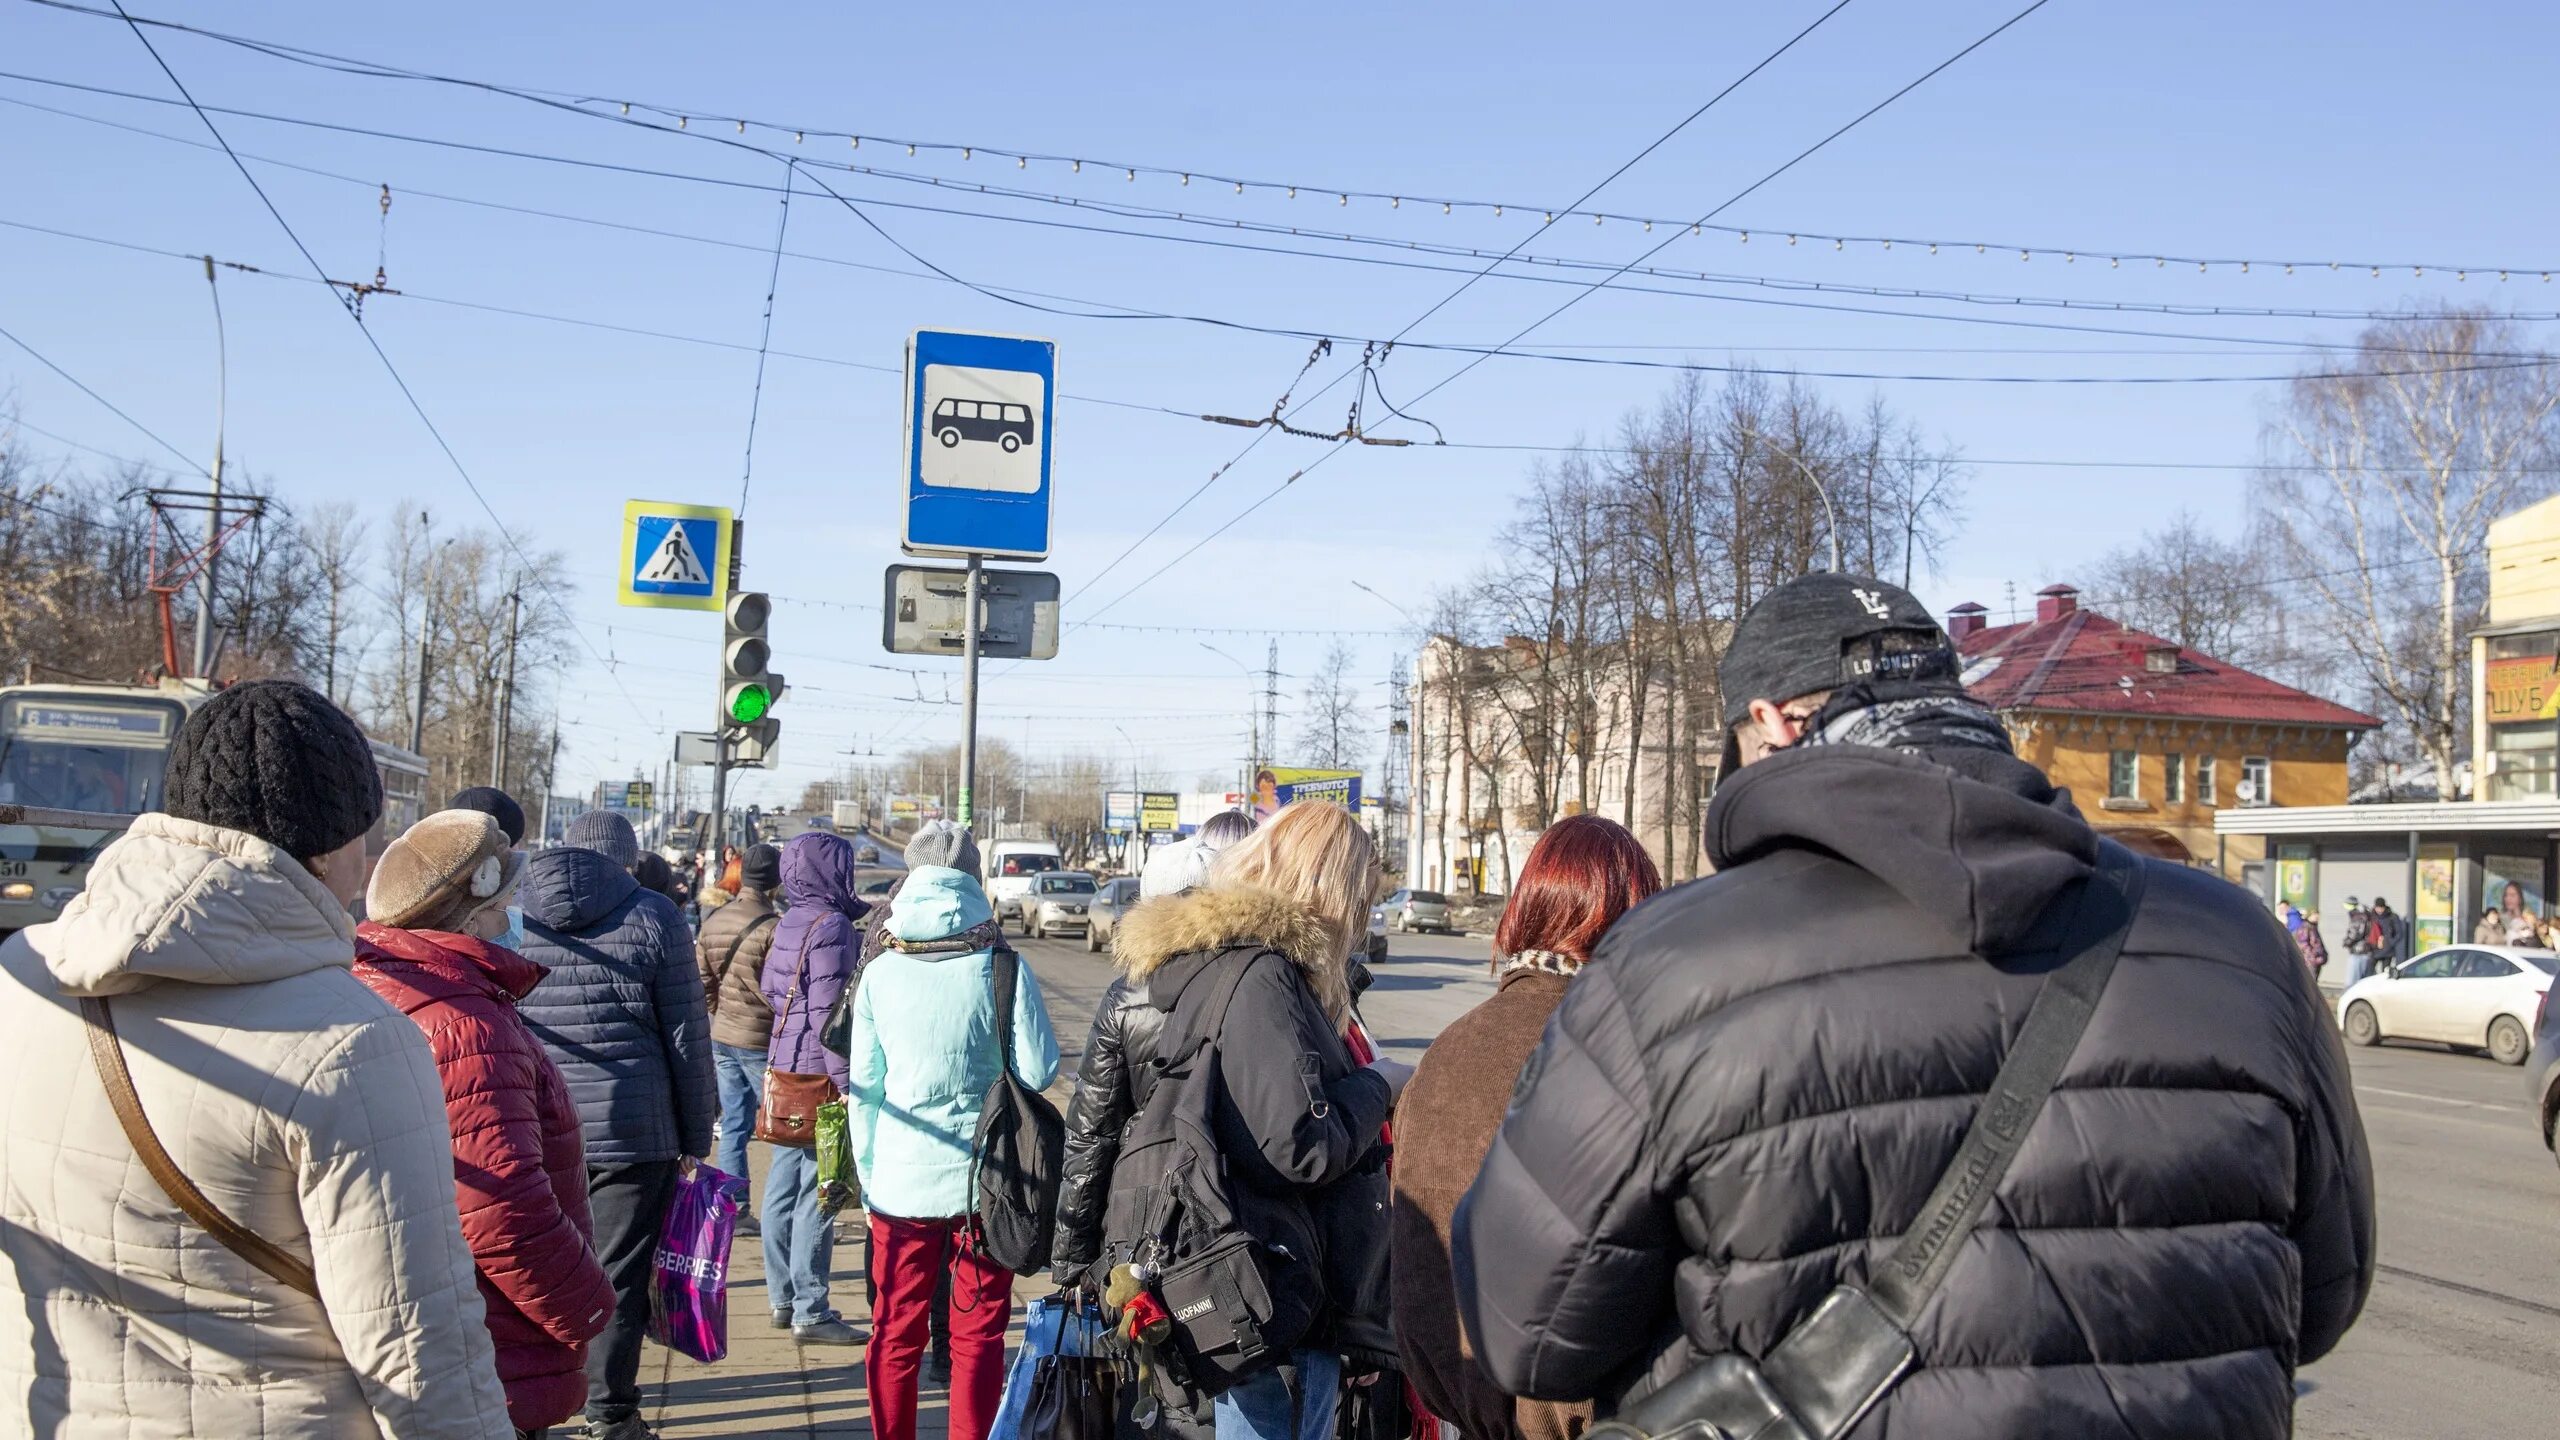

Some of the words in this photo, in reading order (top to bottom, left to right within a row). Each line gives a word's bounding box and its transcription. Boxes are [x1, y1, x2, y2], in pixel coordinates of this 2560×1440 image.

[2488, 663, 2559, 686] ПЕРЕШИ
[2491, 687, 2544, 714] ШУБ
[27, 709, 41, 726] 6
